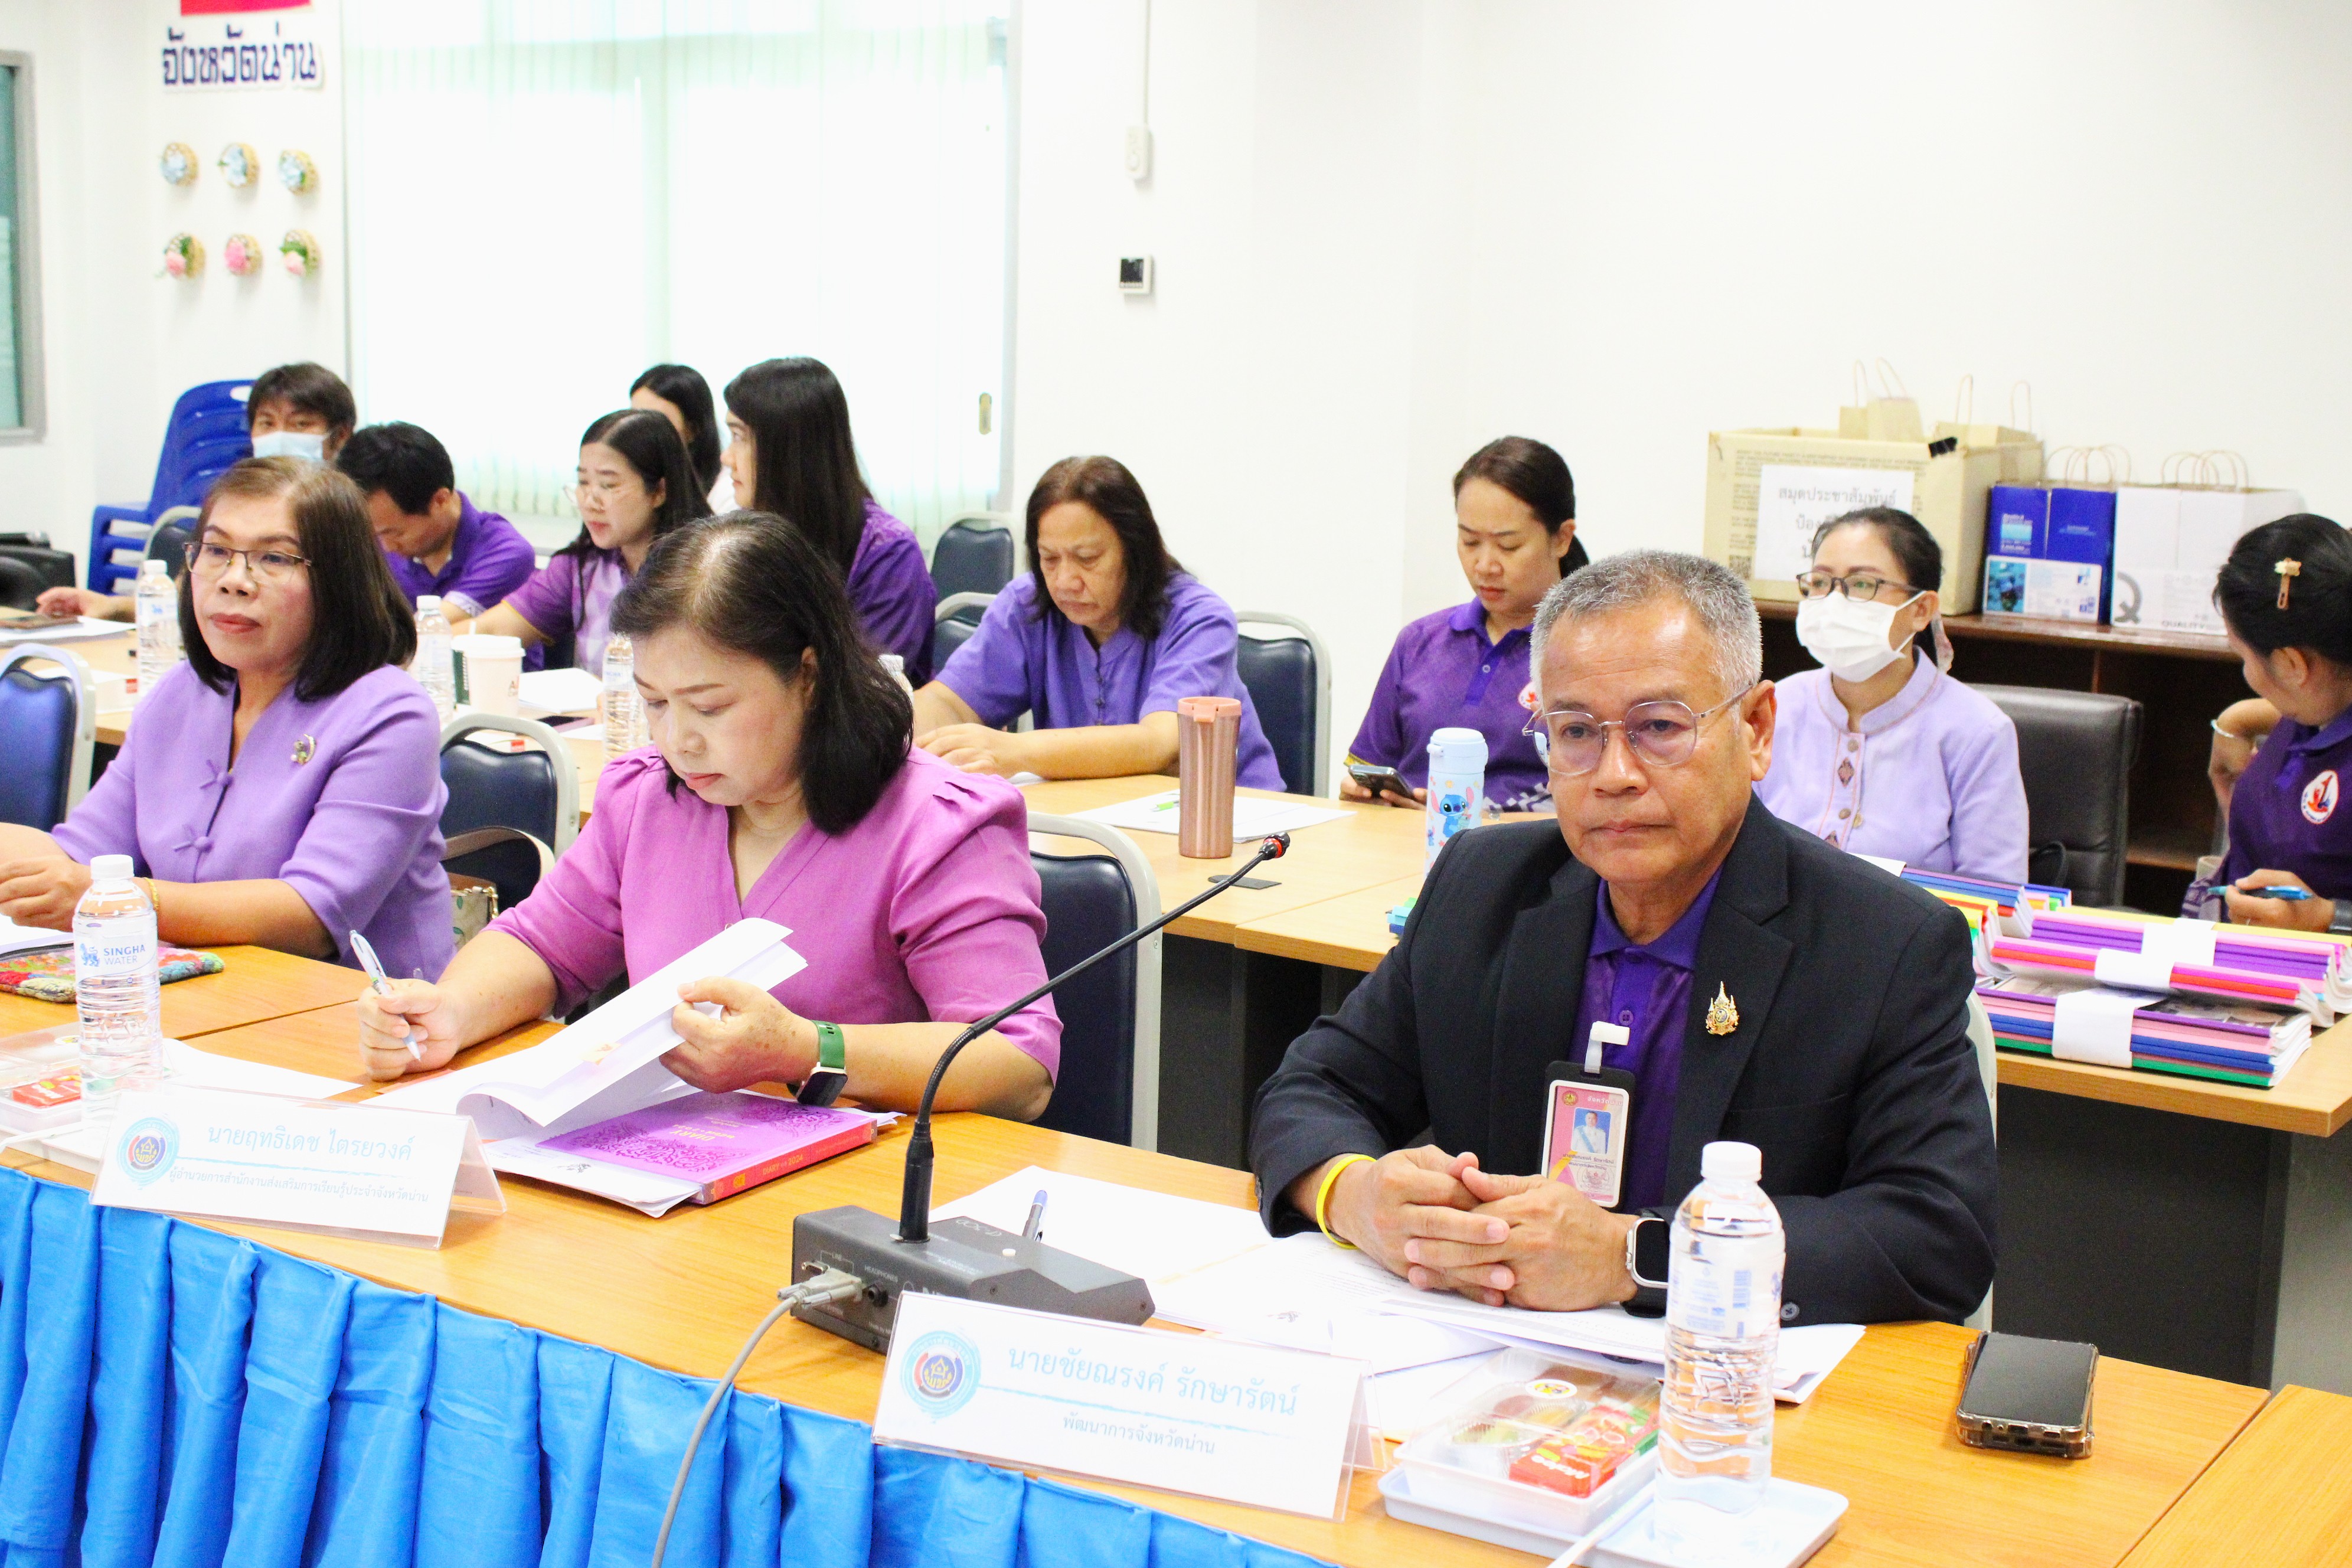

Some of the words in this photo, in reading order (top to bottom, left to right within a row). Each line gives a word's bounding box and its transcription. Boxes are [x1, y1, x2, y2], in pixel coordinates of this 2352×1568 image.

[162, 20, 316, 85] จังหวัดน่าน
[1778, 486, 1897, 507] สมุดประชาสัมพันธ์
[103, 944, 146, 956] SINGHA
[104, 955, 138, 965] WATER
[208, 1124, 321, 1152] นายฤทธิเดช
[329, 1127, 416, 1161] ไตรยวงค์
[669, 1129, 716, 1142] DIARY
[762, 1164, 779, 1176] DIARY
[788, 1155, 804, 1167] 2024
[864, 1265, 899, 1283] HEADPHONES
[1008, 1347, 1169, 1393] นายชัยณรงค์
[1177, 1366, 1301, 1416] รักษารัตน์
[1063, 1411, 1215, 1455] พัฒนาการจังหวัดน่าน
